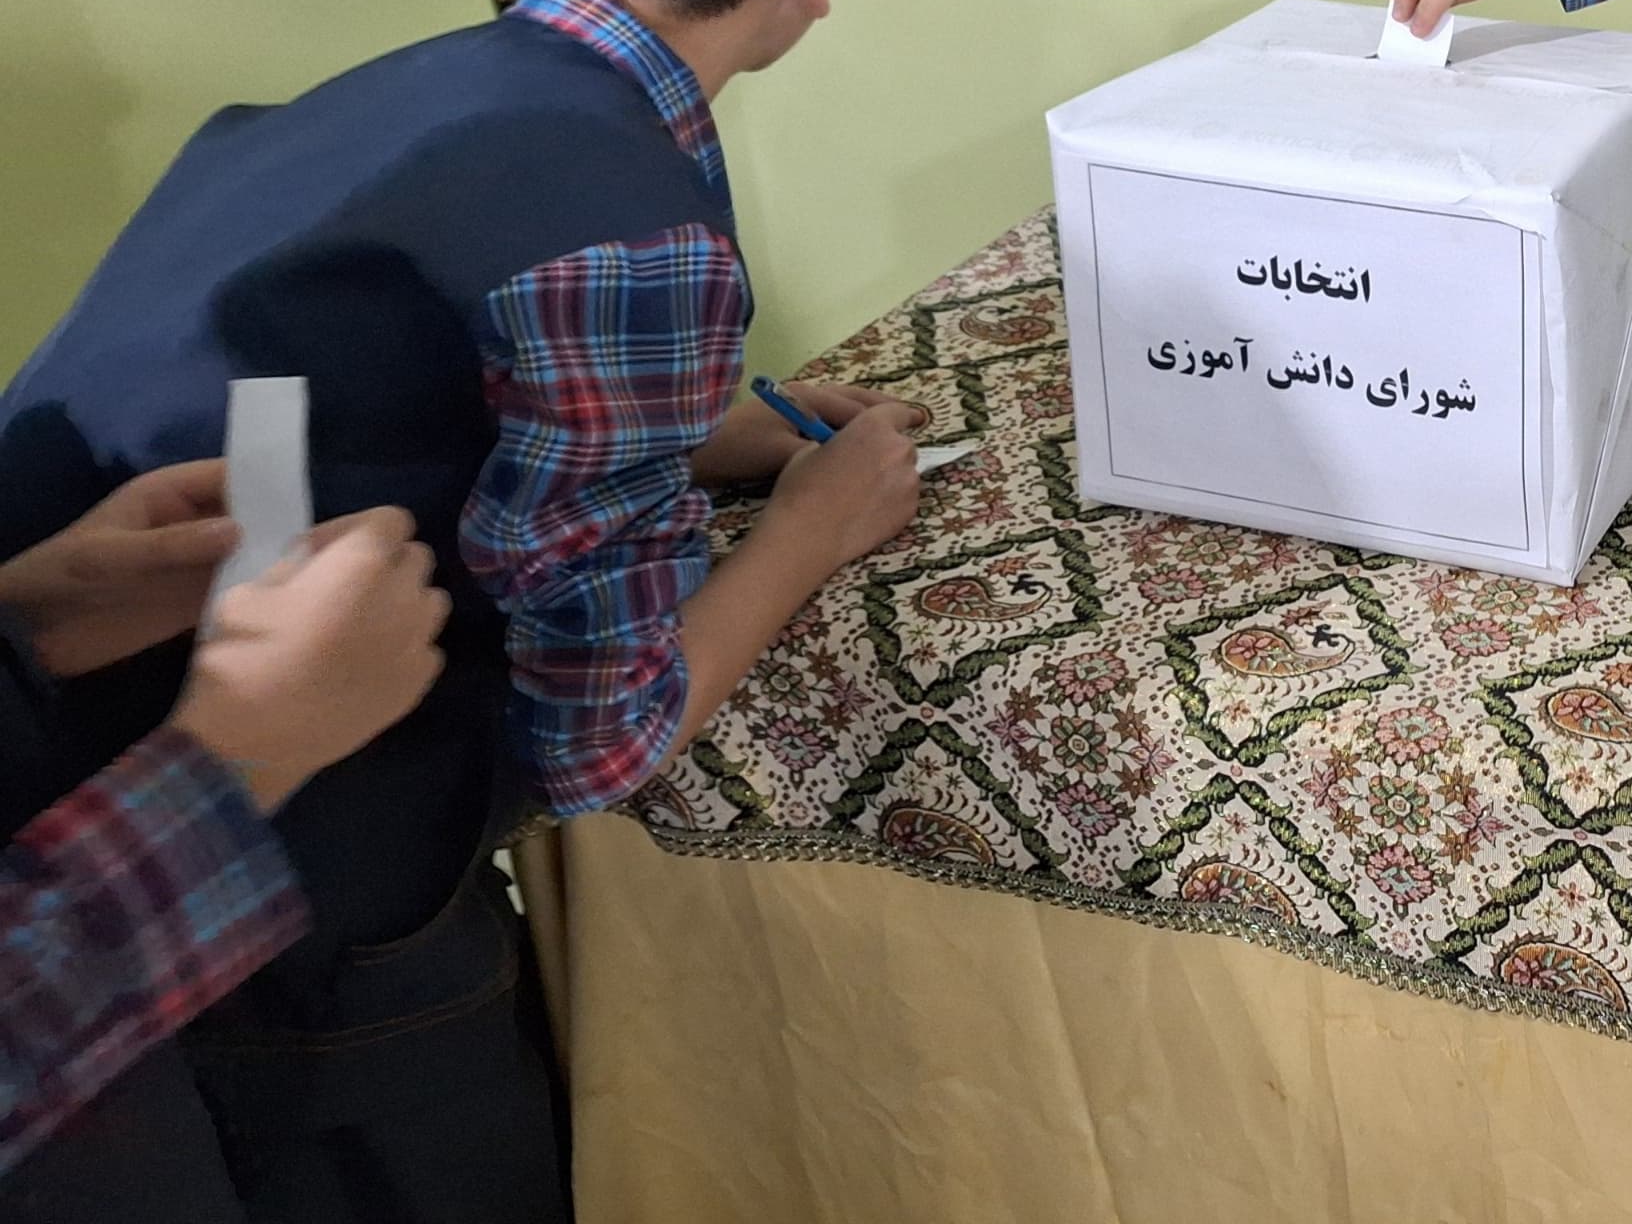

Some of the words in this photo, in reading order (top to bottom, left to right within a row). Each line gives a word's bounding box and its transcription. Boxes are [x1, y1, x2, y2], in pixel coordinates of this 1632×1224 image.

[1236, 255, 1371, 303] انتخابات
[1147, 336, 1254, 378] آموزی
[1266, 350, 1354, 390] دانش
[1366, 368, 1477, 419] شورای
